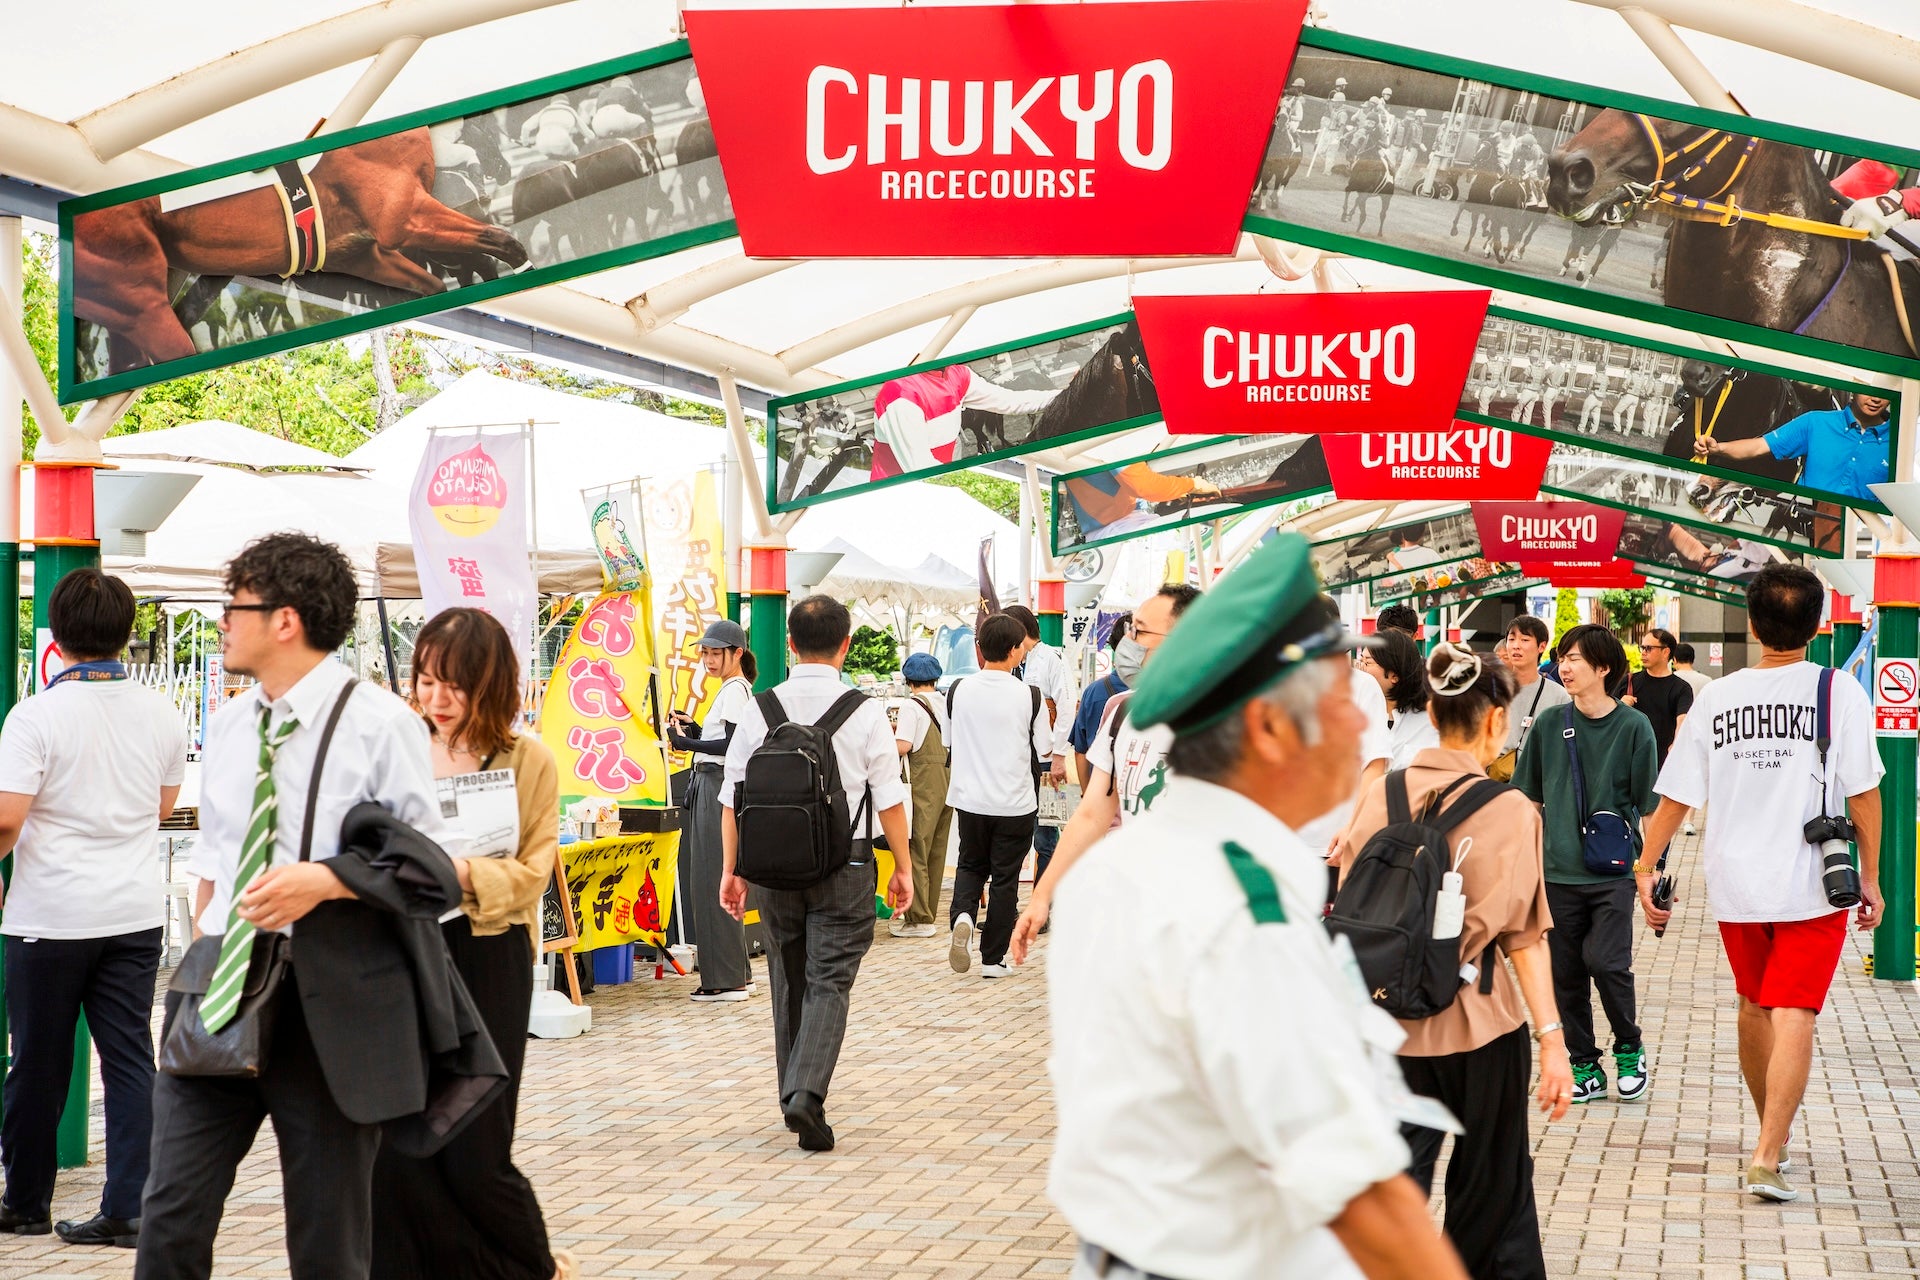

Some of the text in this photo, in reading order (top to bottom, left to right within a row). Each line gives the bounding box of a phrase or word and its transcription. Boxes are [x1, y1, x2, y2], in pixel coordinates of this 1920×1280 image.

[805, 58, 1174, 175] CHUKYO
[881, 168, 1096, 200] RACECOURSE
[1203, 323, 1416, 389] CHUKYO
[1246, 384, 1371, 402] RACECOURSE
[1360, 428, 1513, 469] CHUKYO
[1391, 465, 1481, 479] RACECOURSE
[1501, 514, 1597, 543] CHUKYO
[1521, 540, 1577, 550] RACECOURSE
[1713, 704, 1816, 750] SHOHOKU
[1751, 761, 1781, 769] TEAM
[456, 770, 510, 788] PROGRAM
[1372, 988, 1389, 1001] K
